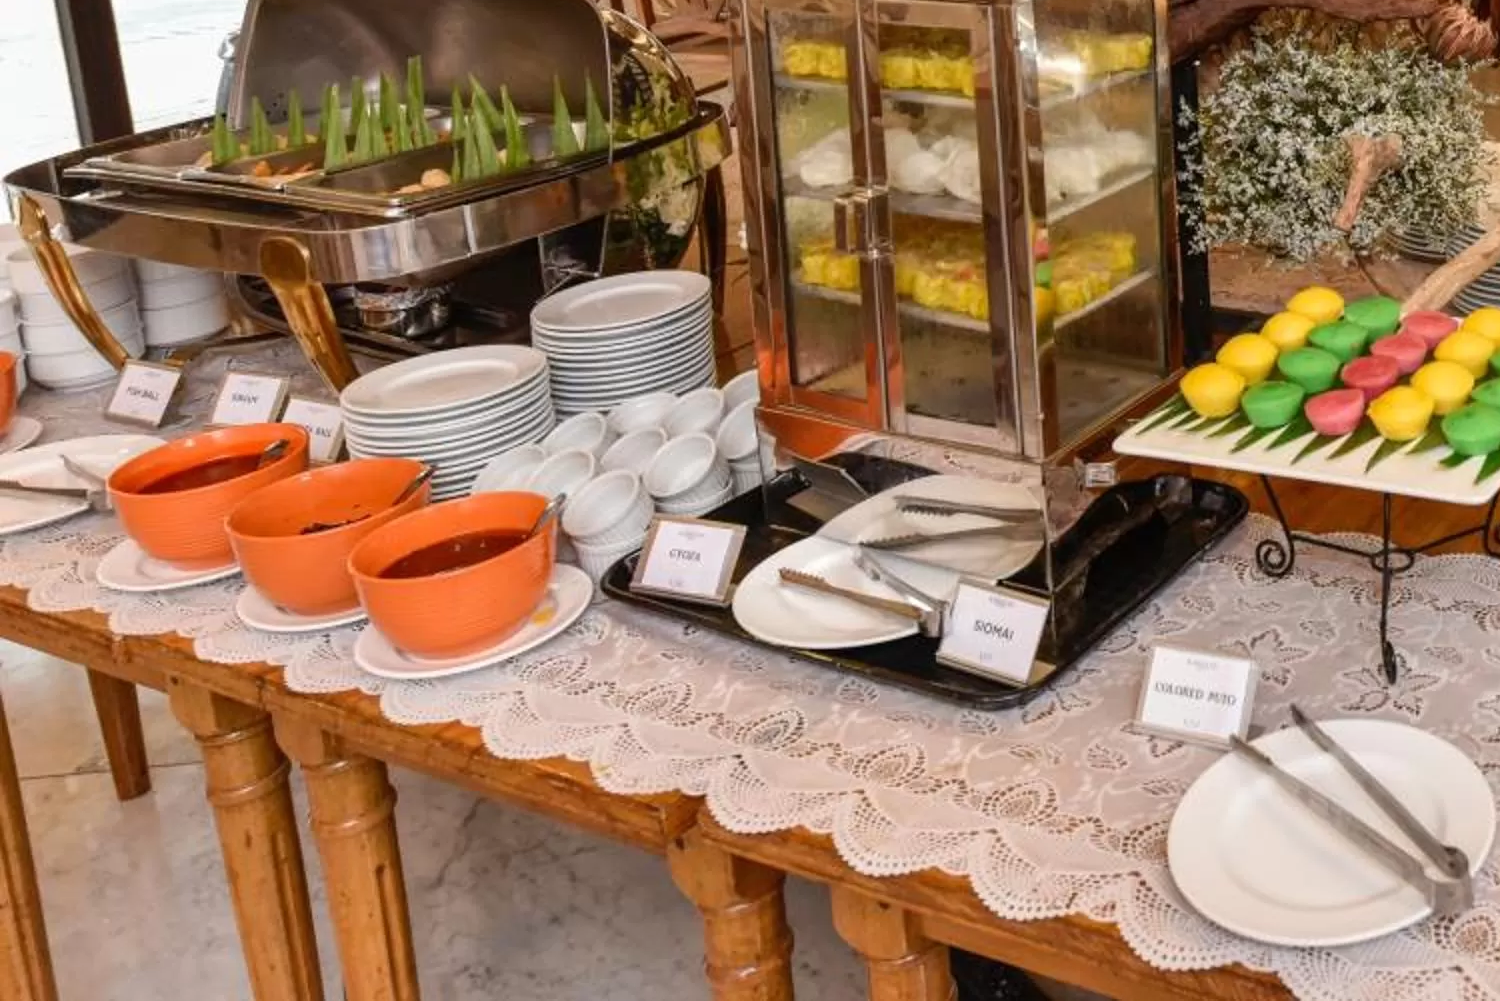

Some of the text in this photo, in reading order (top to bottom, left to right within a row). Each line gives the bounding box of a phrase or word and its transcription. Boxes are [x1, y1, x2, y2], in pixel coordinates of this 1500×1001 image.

[974, 619, 1015, 640] SIOMAI
[1154, 682, 1237, 706] COLORED PUTO
